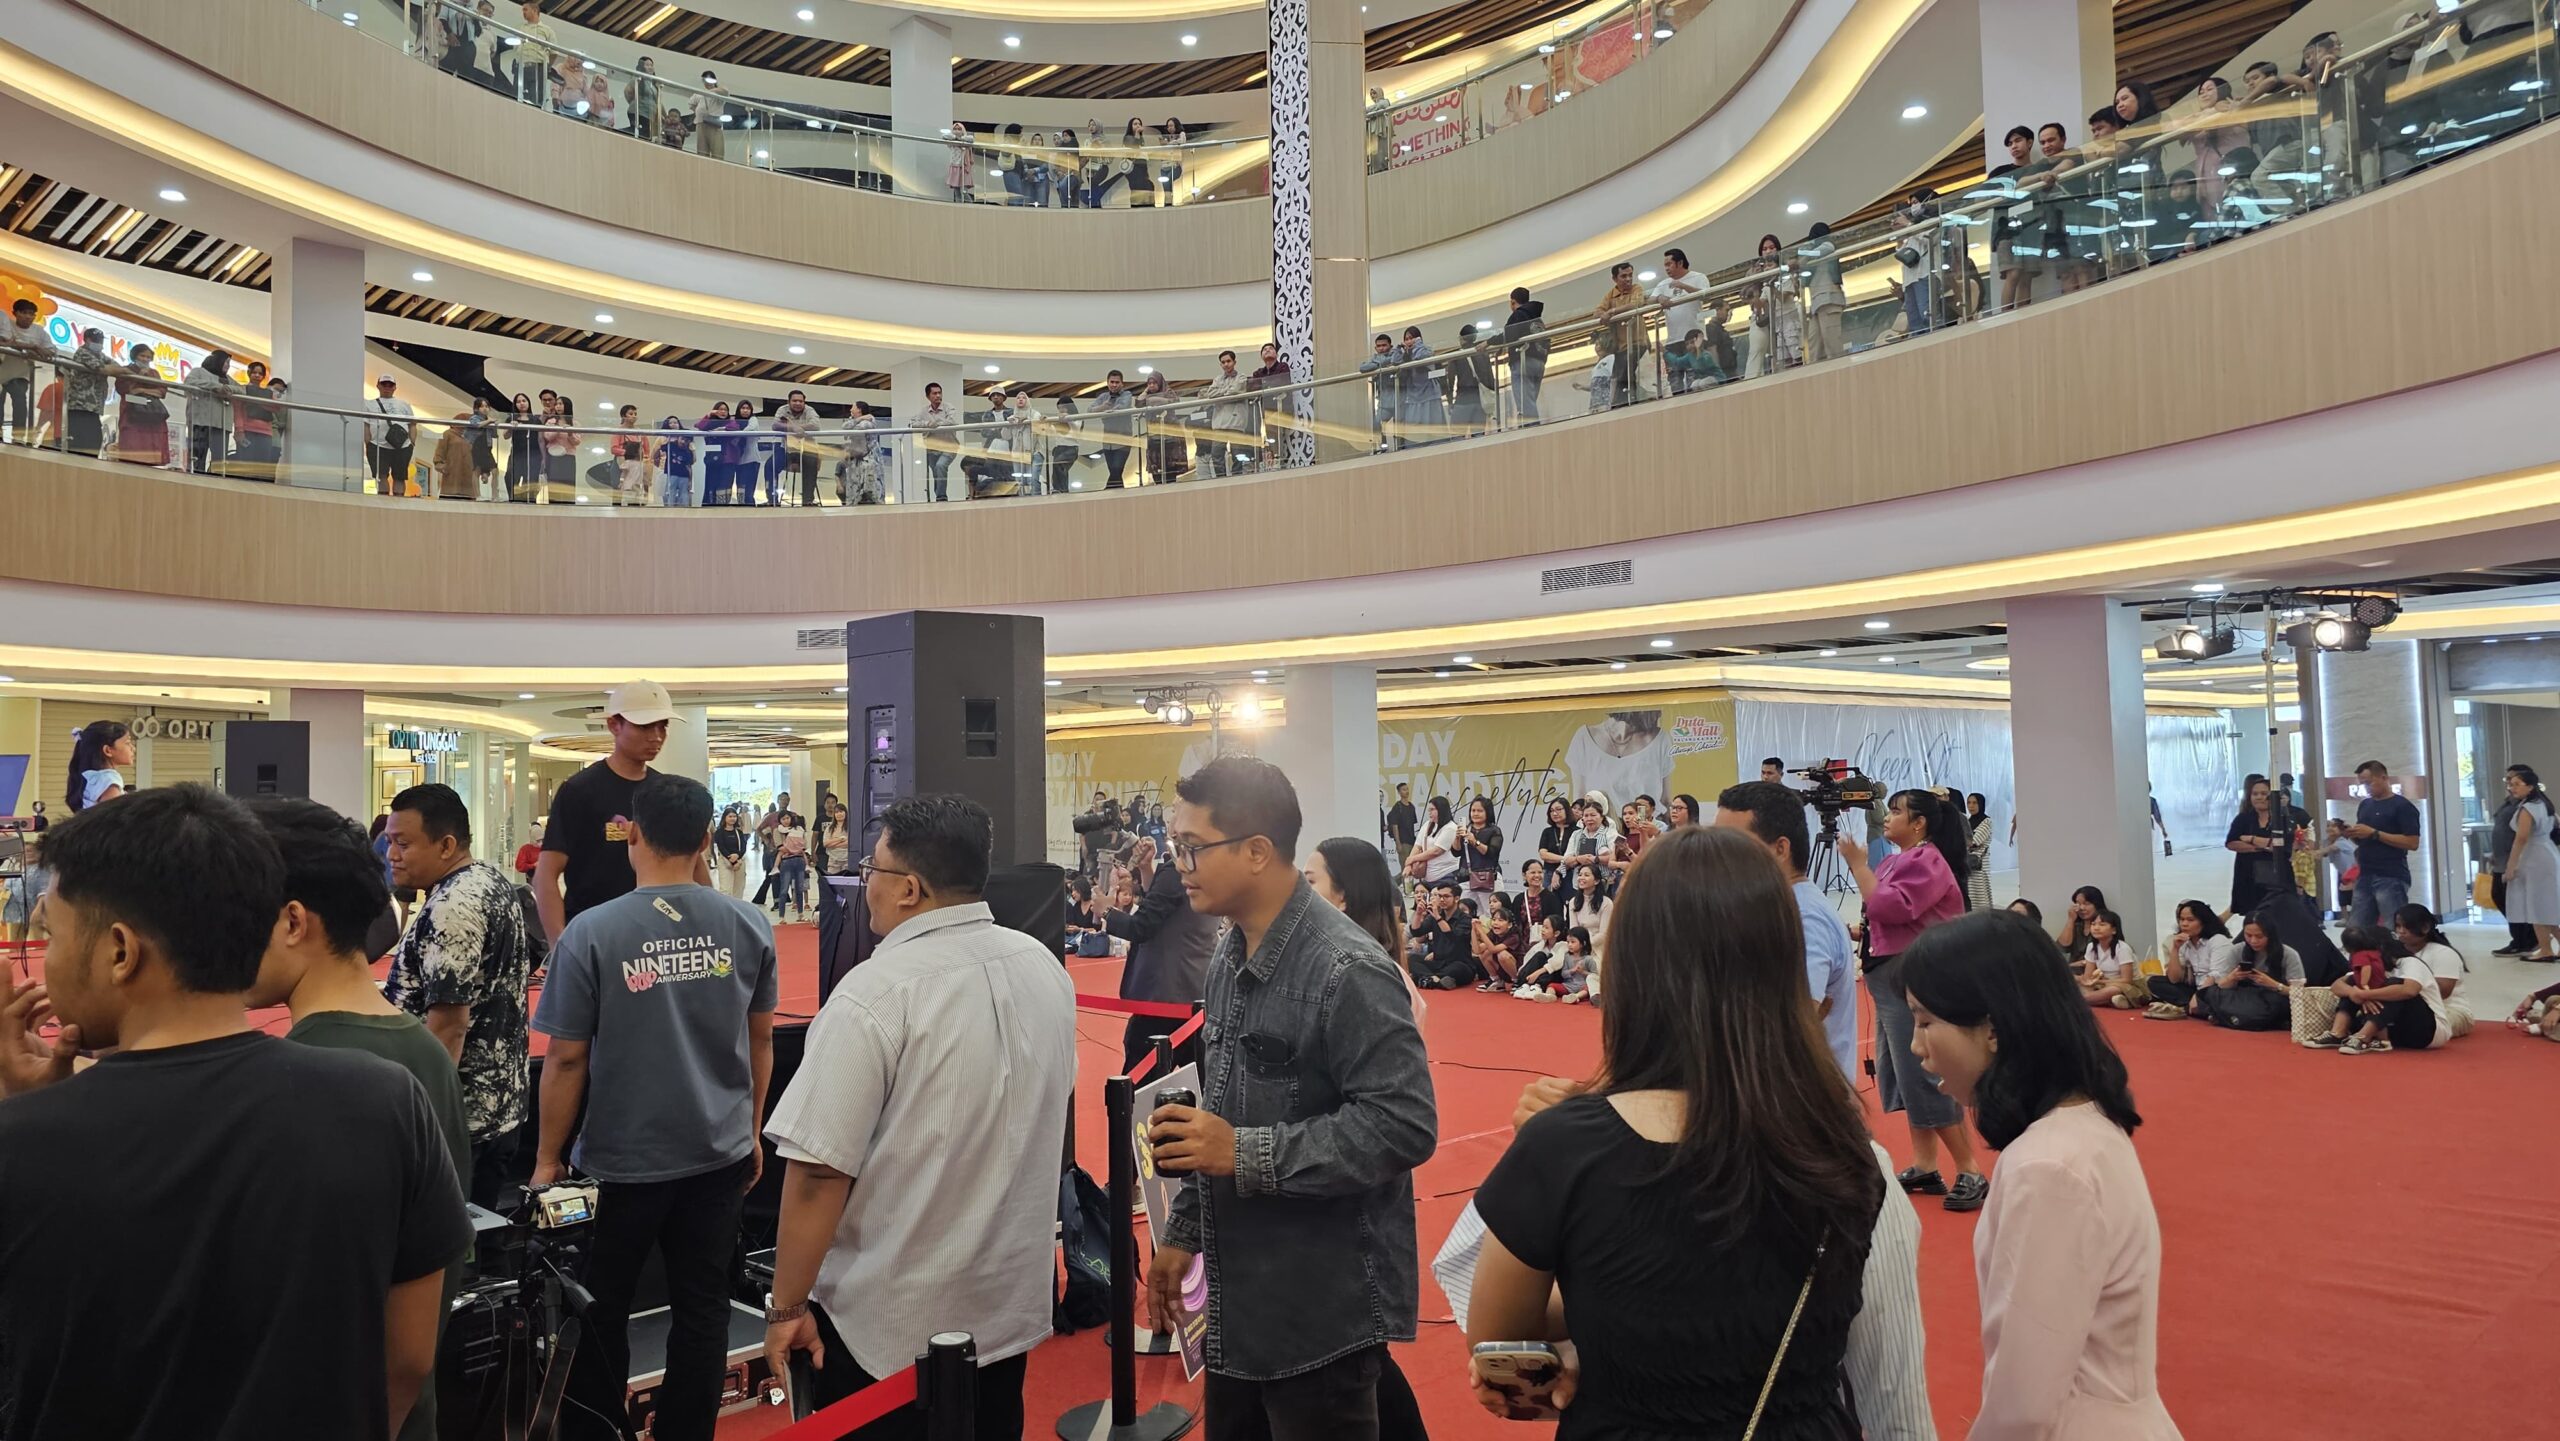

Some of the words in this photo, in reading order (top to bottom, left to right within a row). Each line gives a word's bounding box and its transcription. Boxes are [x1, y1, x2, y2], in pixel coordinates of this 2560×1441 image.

[49, 316, 86, 345] OY
[418, 731, 459, 751] TUNGGAL
[1692, 726, 1718, 736] Mall
[1047, 751, 1096, 777] DAY
[642, 935, 716, 953] OFFICIAL
[622, 947, 732, 982] NINETEENS
